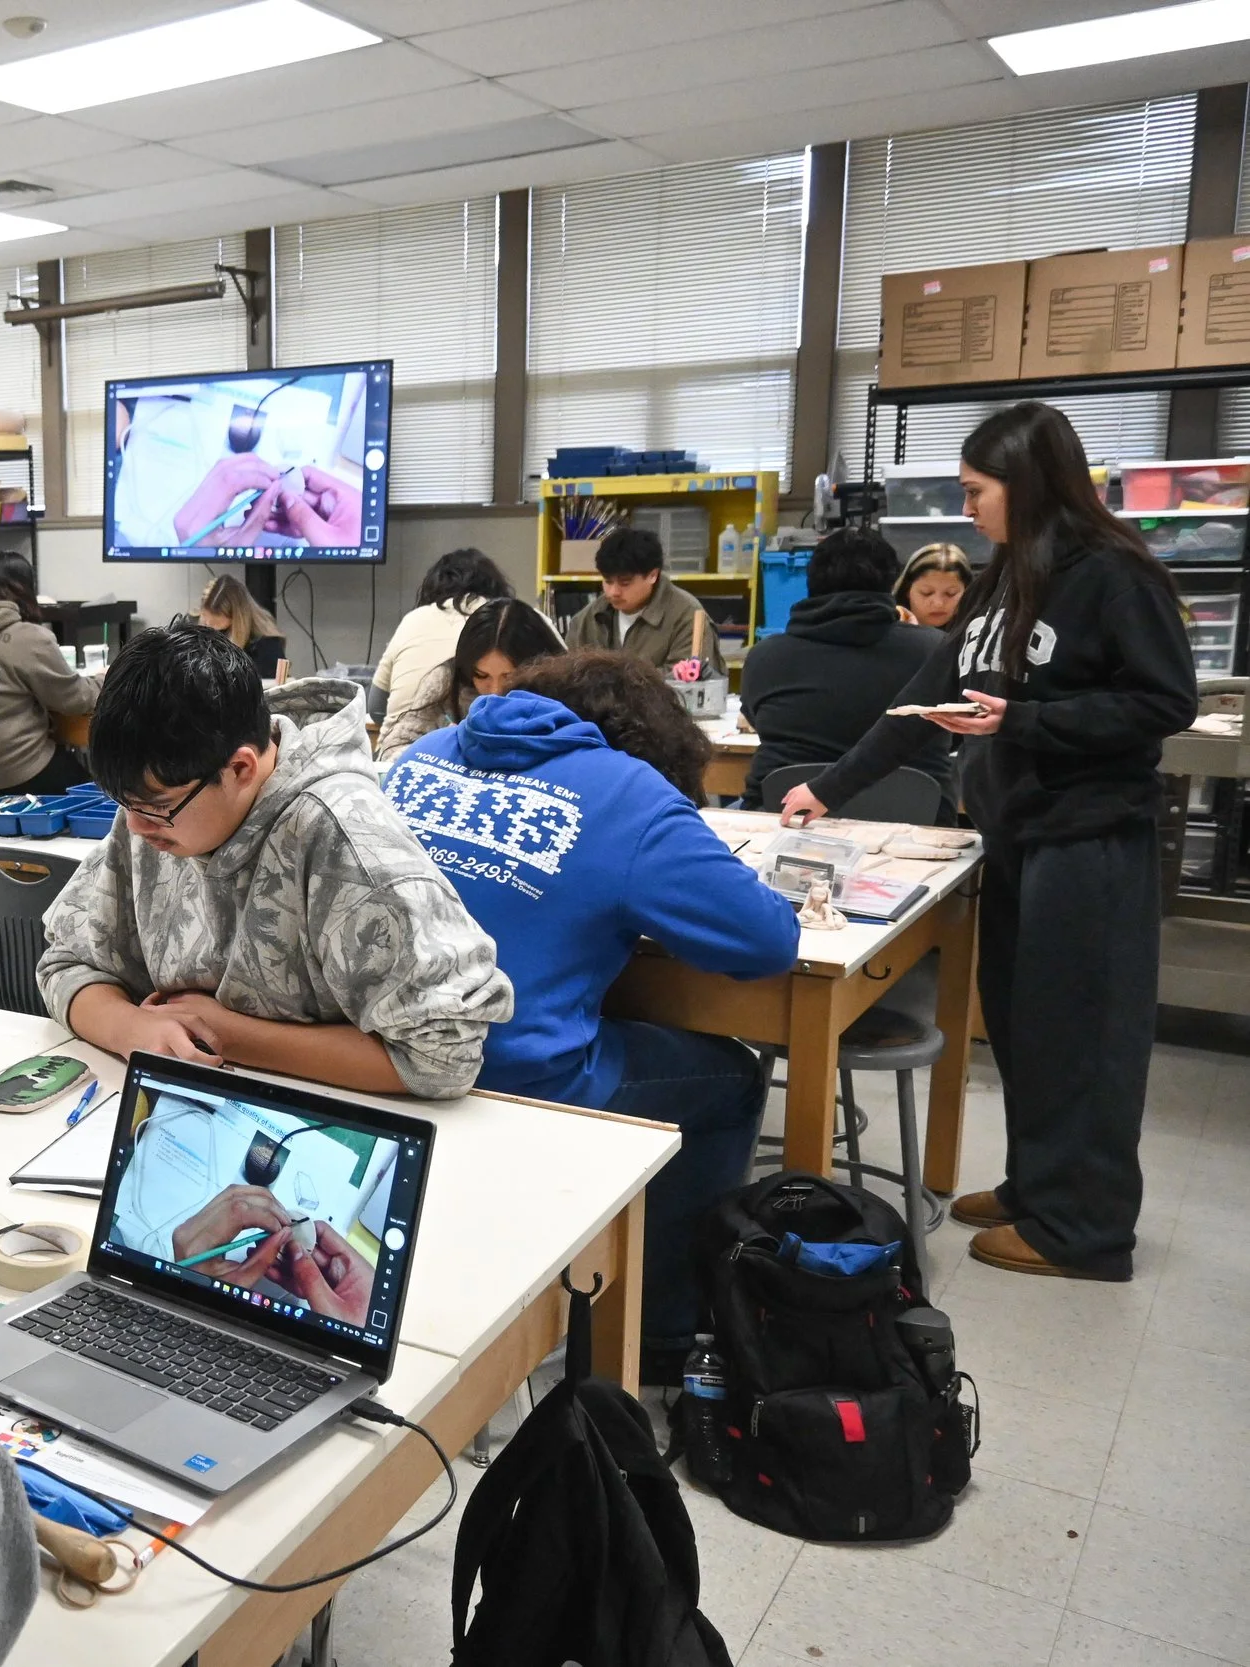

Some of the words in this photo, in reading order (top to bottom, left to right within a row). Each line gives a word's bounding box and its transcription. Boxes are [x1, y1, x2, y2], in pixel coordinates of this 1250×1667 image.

[438, 759, 468, 774] MAKE
[488, 770, 505, 782] WE
[507, 774, 551, 791] BREAK
[454, 868, 478, 880] Company
[512, 875, 544, 896] Engineered
[518, 883, 540, 900] Destroy
[241, 1107, 260, 1123] quality
